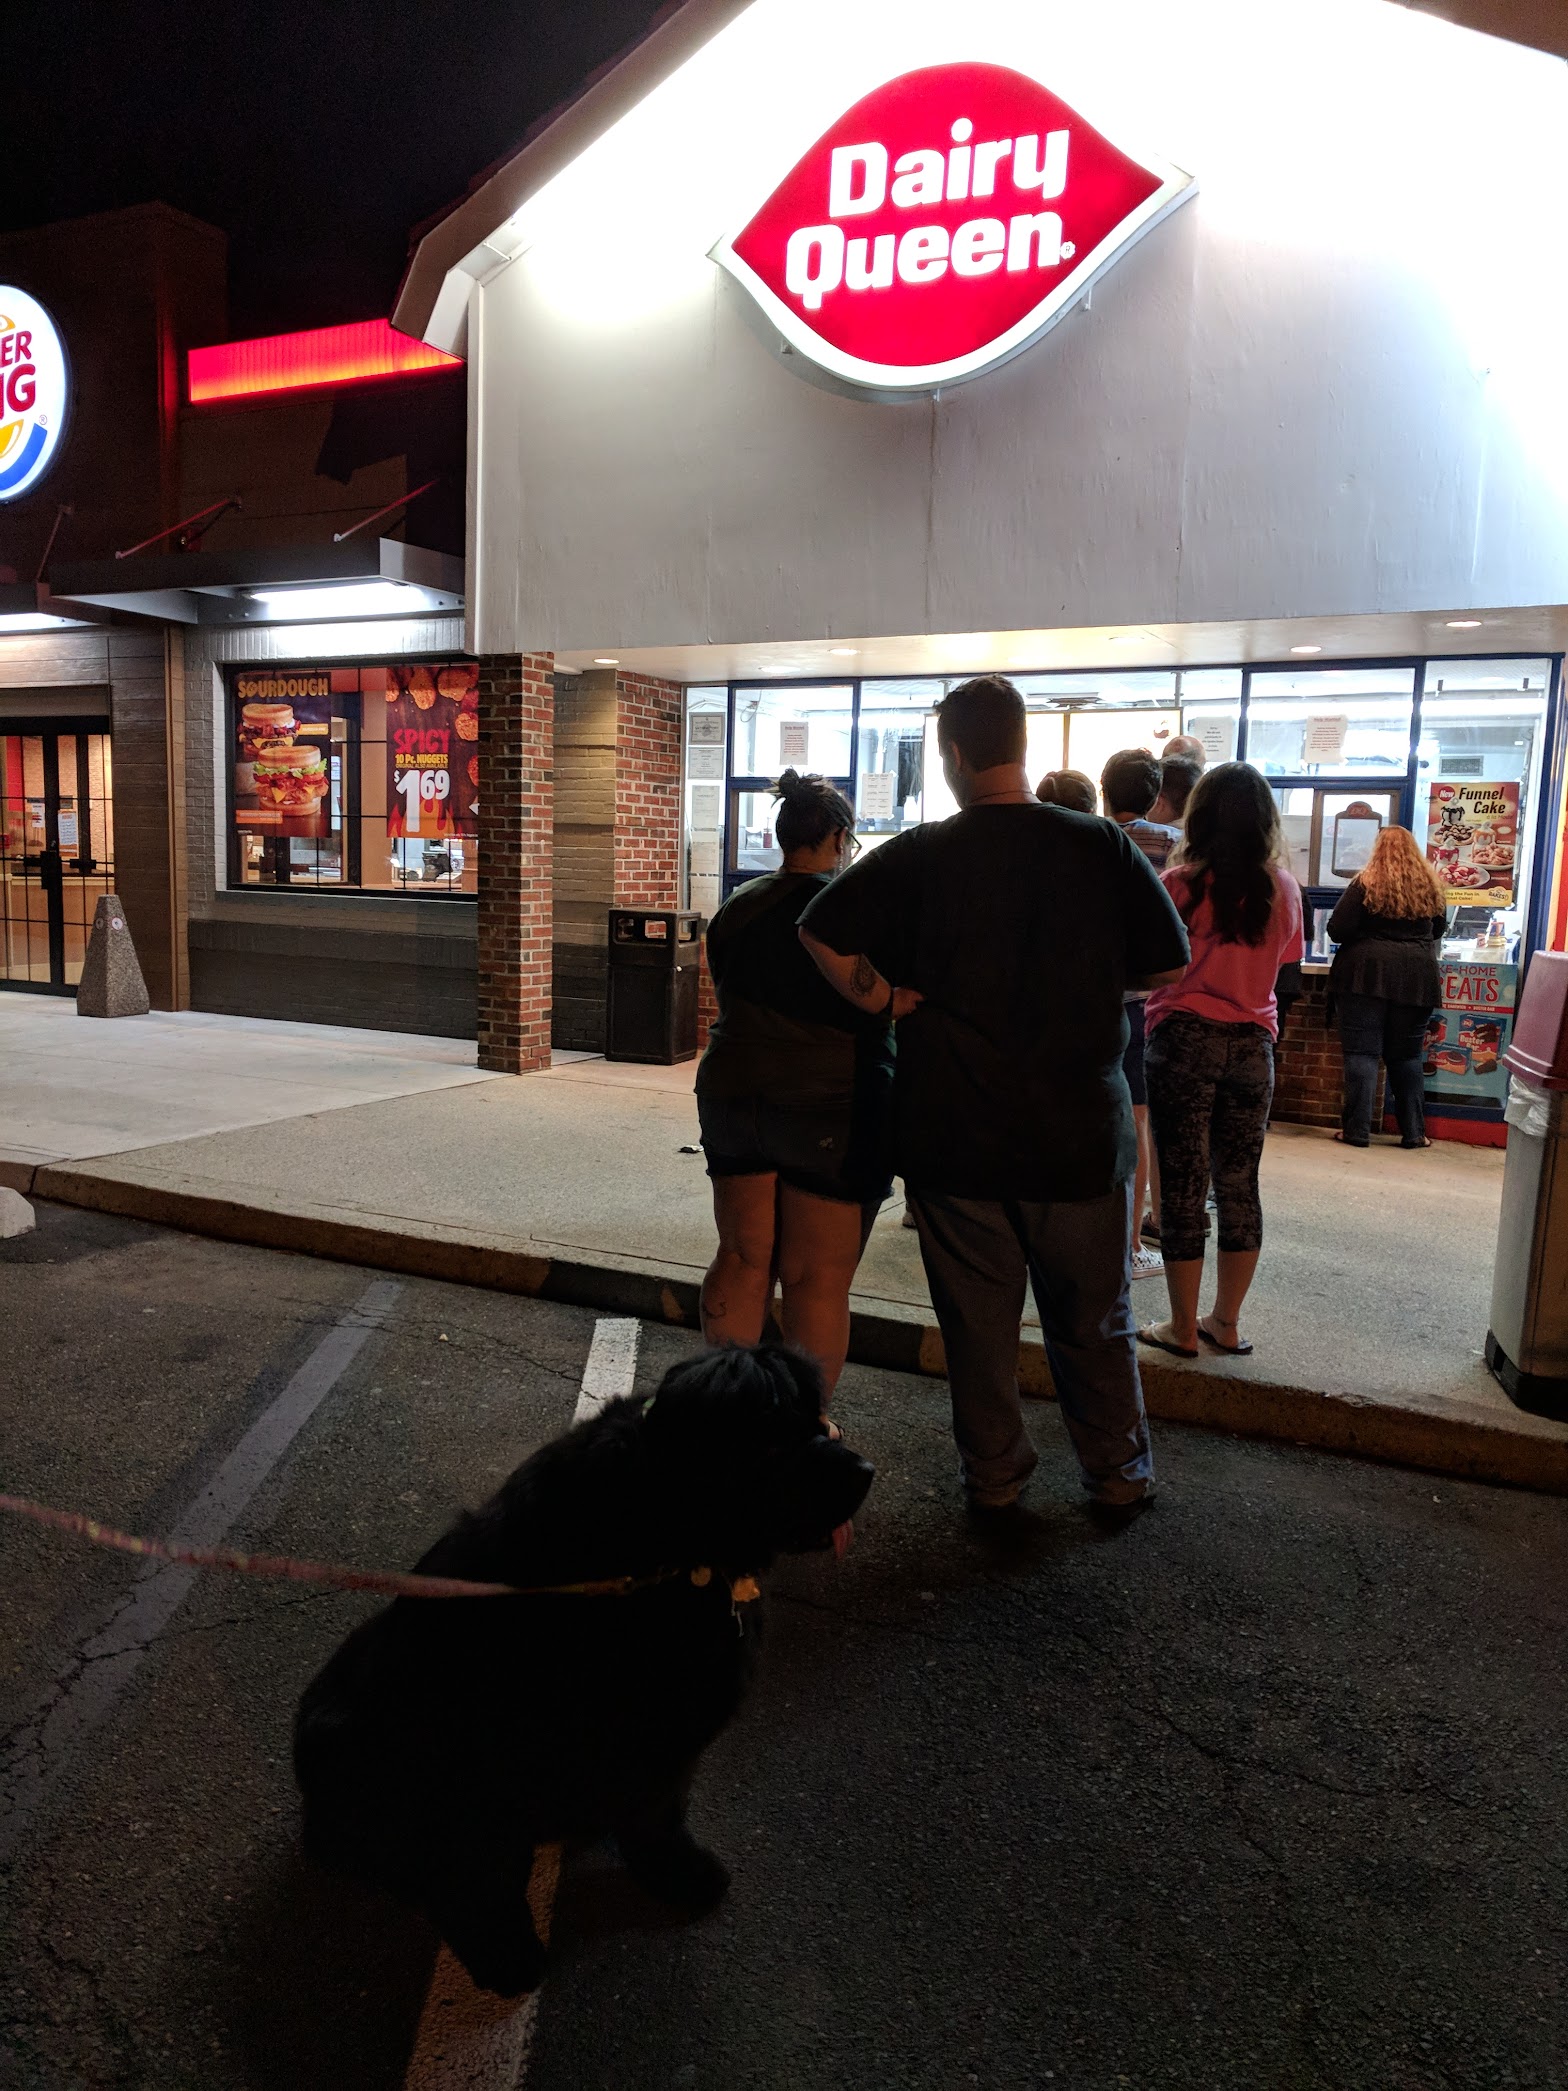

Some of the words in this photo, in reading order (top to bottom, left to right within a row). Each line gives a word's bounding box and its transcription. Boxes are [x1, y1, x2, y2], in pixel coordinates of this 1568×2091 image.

[829, 117, 1070, 218] Dairy
[786, 211, 1064, 309] Queen
[238, 678, 328, 698] SOURDOUGH
[394, 728, 451, 754] SPICY
[395, 754, 404, 763] 10
[416, 754, 448, 763] NUGGETS
[1440, 790, 1454, 798] New
[1459, 787, 1505, 799] Funnel
[1473, 801, 1506, 813] Cake
[1460, 1035, 1484, 1044] Buster
